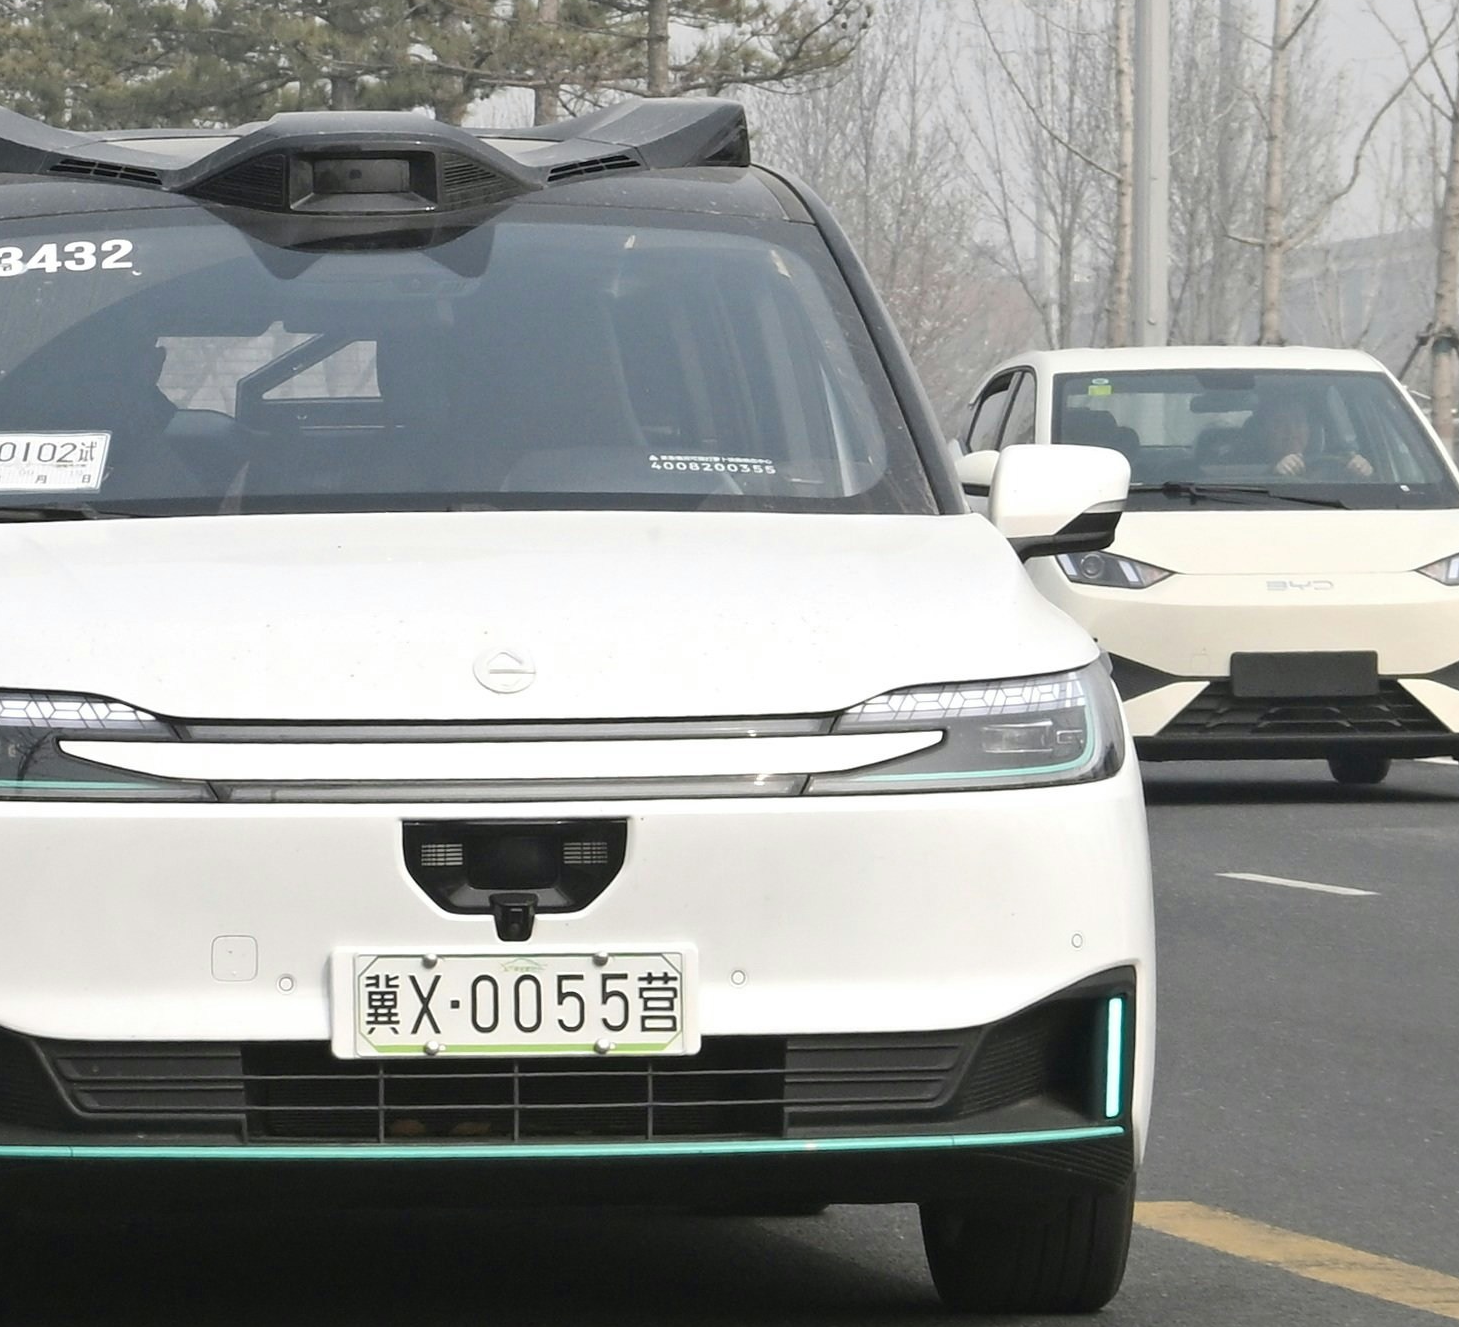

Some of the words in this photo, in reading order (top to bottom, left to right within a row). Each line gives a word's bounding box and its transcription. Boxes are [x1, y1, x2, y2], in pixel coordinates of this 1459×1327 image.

[651, 461, 776, 474] 4008200355
[1266, 580, 1334, 592] BYD
[365, 972, 678, 1035] 冀X·0055营
